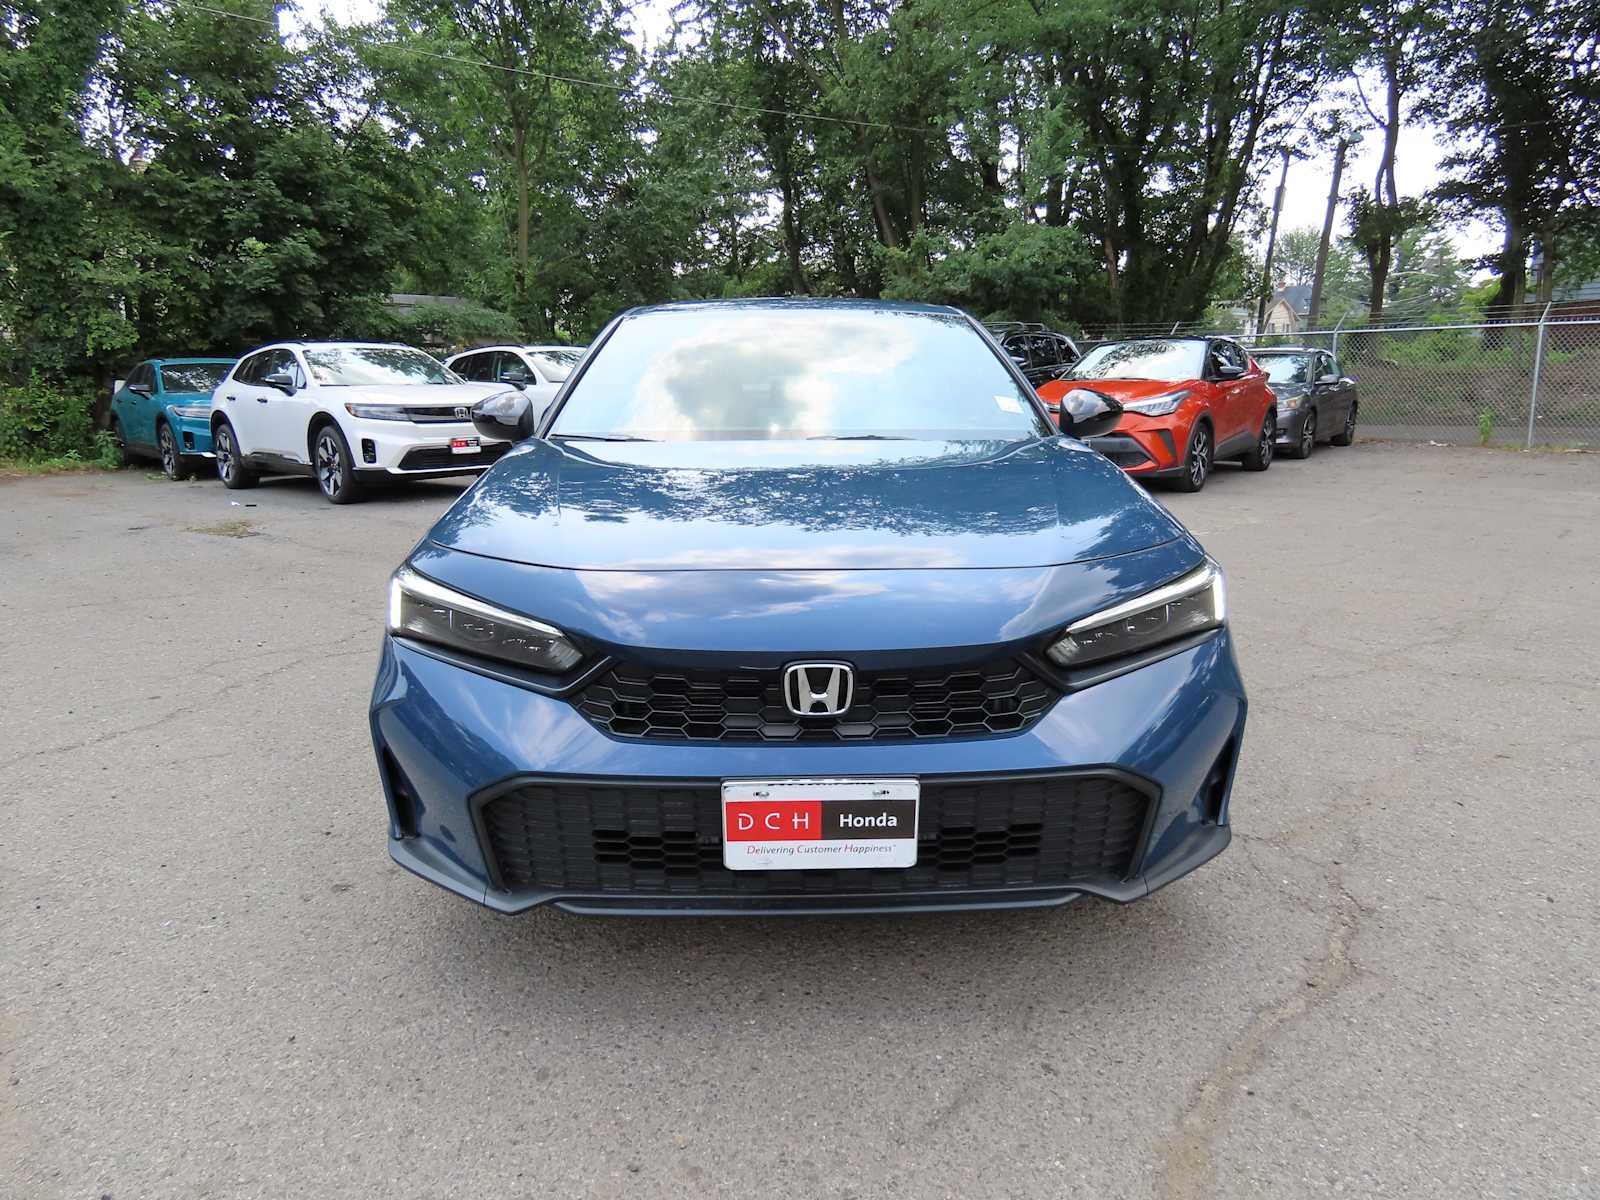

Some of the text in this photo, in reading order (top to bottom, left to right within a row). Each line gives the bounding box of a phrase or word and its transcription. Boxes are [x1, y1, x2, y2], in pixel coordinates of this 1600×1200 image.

[839, 812, 898, 828] Honda
[746, 845, 795, 856] Delivering
[797, 844, 842, 854] Customer
